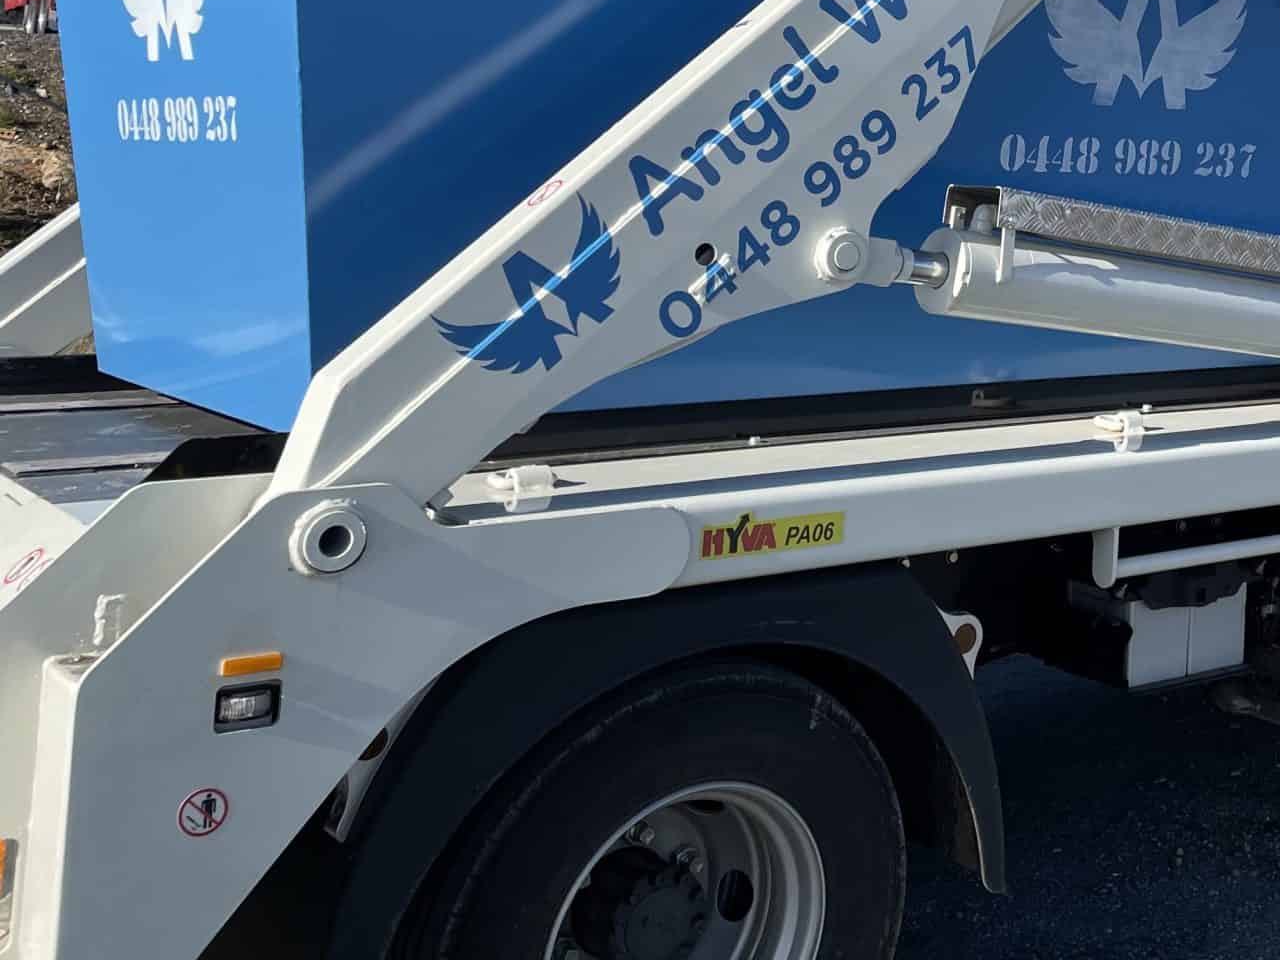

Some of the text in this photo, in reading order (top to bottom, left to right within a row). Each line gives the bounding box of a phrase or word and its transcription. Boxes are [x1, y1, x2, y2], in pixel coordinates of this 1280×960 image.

[117, 95, 238, 142] 0448 989 237
[629, 26, 840, 236] Angel
[1000, 134, 1257, 177] 0448 989 237
[659, 25, 979, 338] 0448 989 237
[702, 513, 835, 557] HYVA PA06
